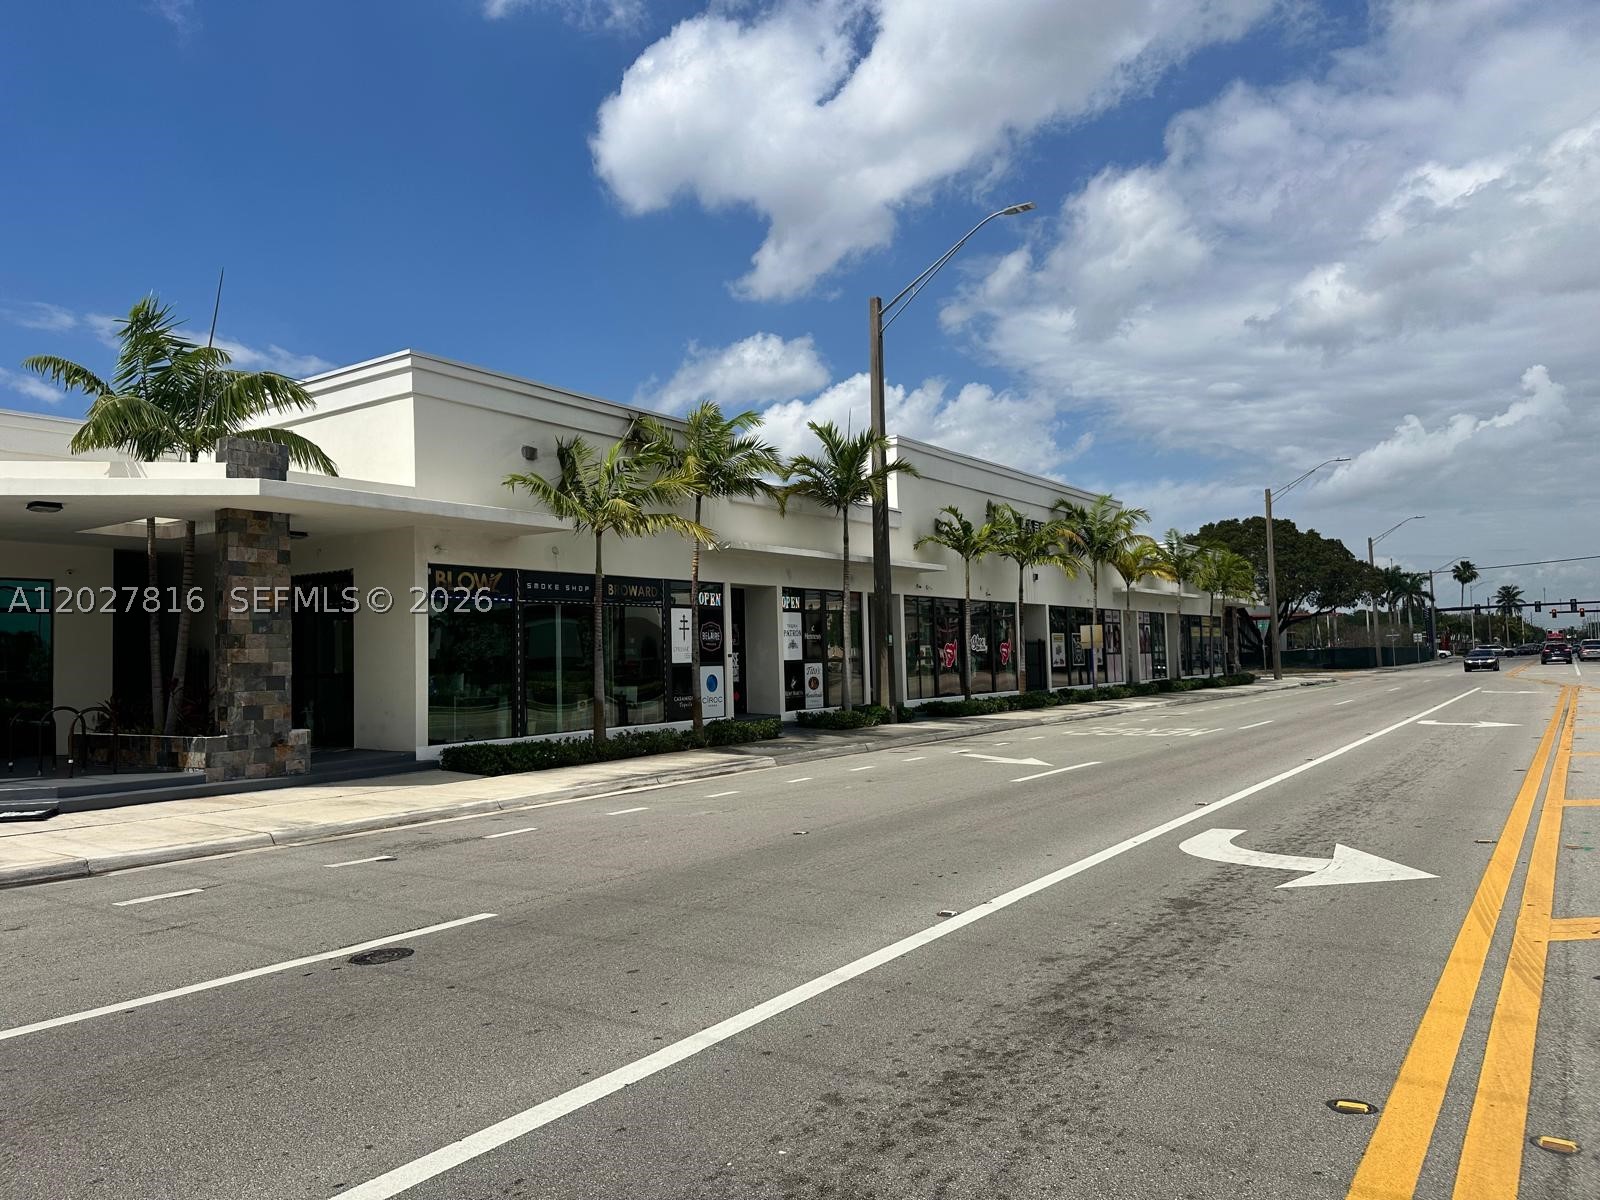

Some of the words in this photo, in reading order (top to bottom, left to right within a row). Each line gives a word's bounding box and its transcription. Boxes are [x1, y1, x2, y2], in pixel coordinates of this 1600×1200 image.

[526, 582, 560, 592] SMOKE
[565, 583, 590, 593] SHOP
[698, 592, 721, 606] OPEN
[782, 596, 800, 609] OPEN
